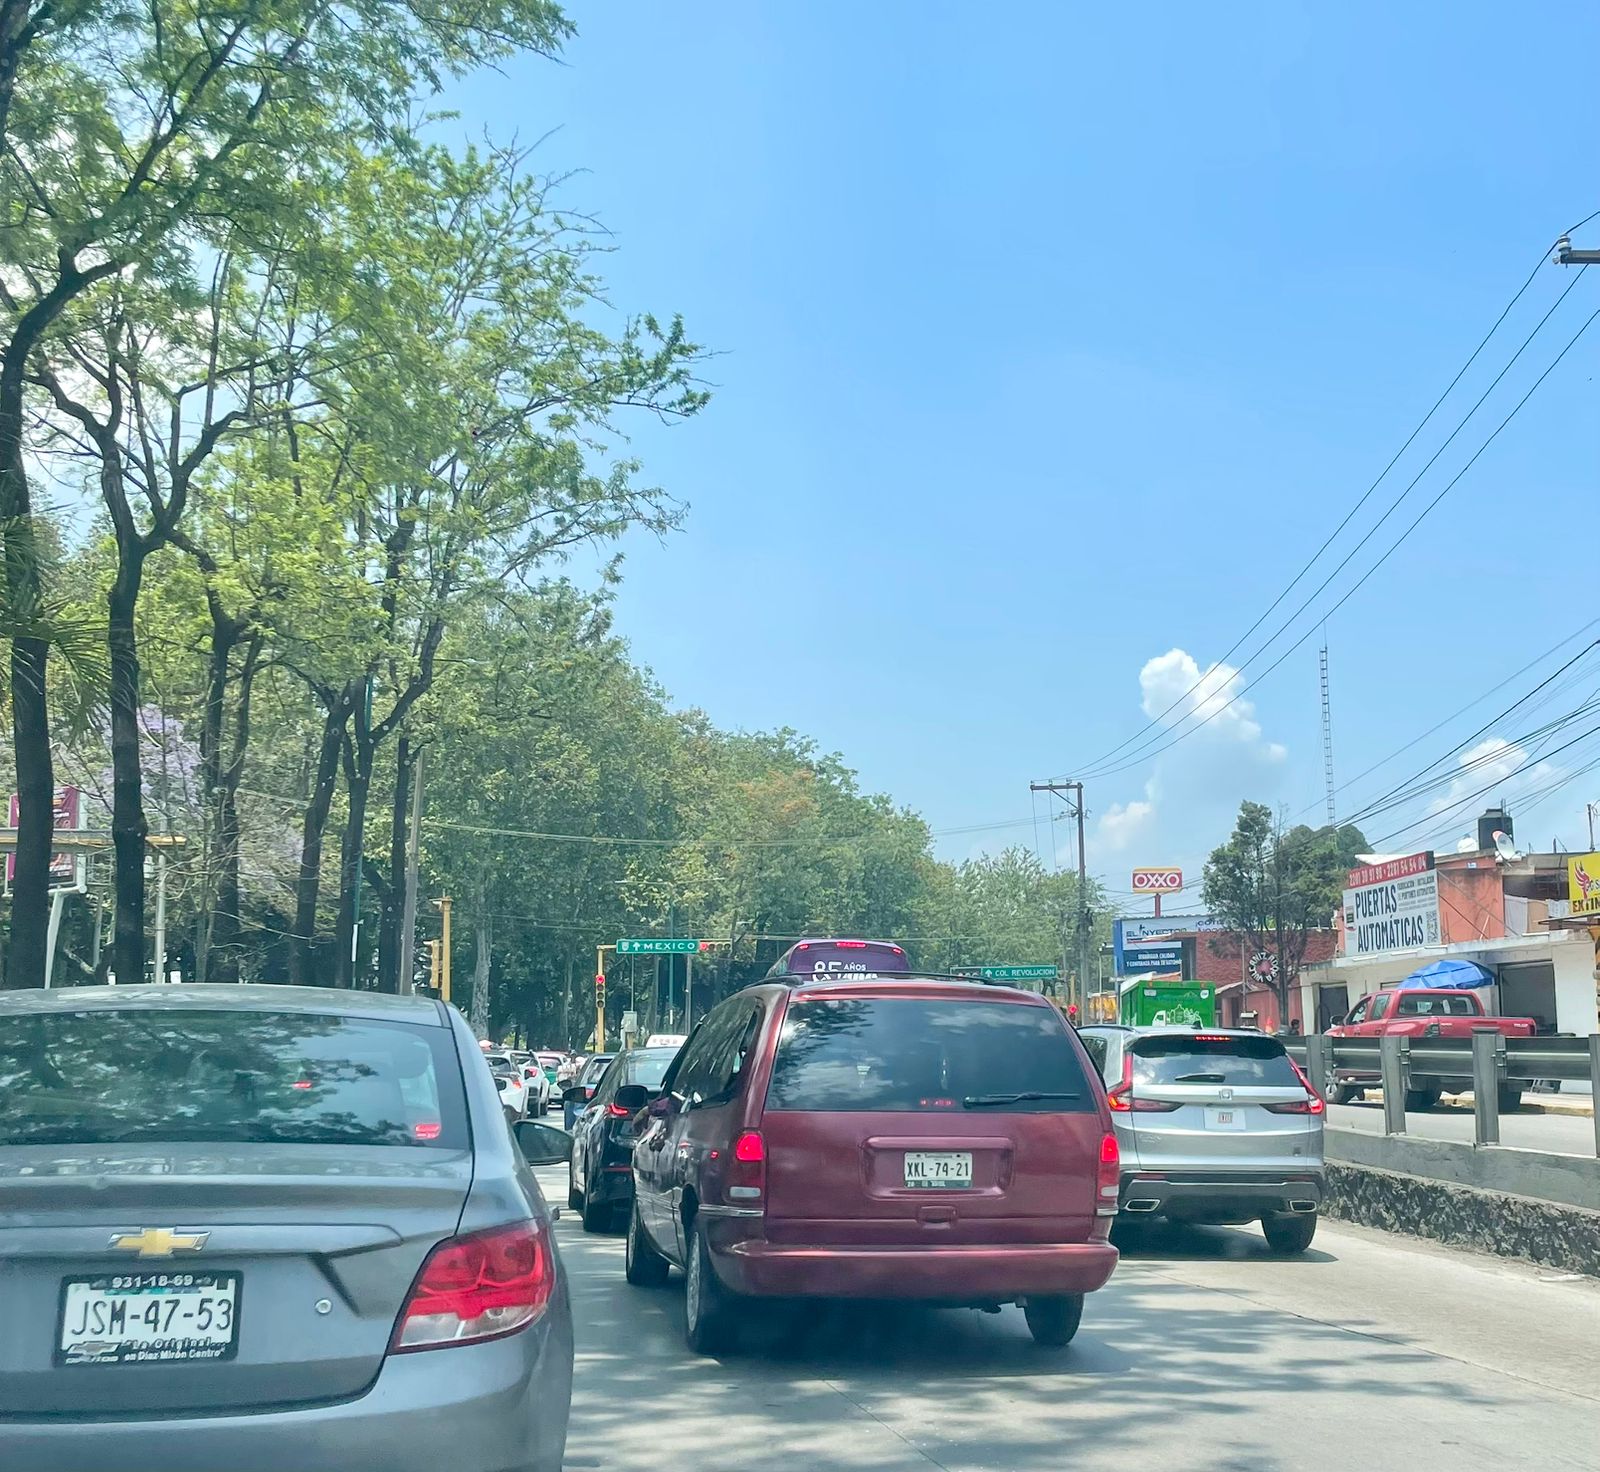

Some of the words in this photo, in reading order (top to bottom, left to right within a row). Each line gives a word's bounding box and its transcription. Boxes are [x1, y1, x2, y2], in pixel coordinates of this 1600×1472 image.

[1134, 873, 1180, 888] OXXO
[1355, 884, 1397, 919] PUERTAS
[1126, 930, 1138, 938] EL
[1357, 914, 1425, 953] AUTOMÁTICAS
[643, 942, 695, 950] MEXICO
[843, 961, 867, 971] AÑOS
[995, 969, 1009, 977] COL
[1011, 968, 1055, 976] REVOLUCION
[1249, 952, 1279, 983] VULCANIZADORA
[907, 1162, 969, 1177] XKL-74-21
[112, 1275, 194, 1288] 931-18-69
[71, 1298, 233, 1336] JSM-47-53
[124, 1353, 136, 1361] en
[160, 1349, 187, 1360] Mirón
